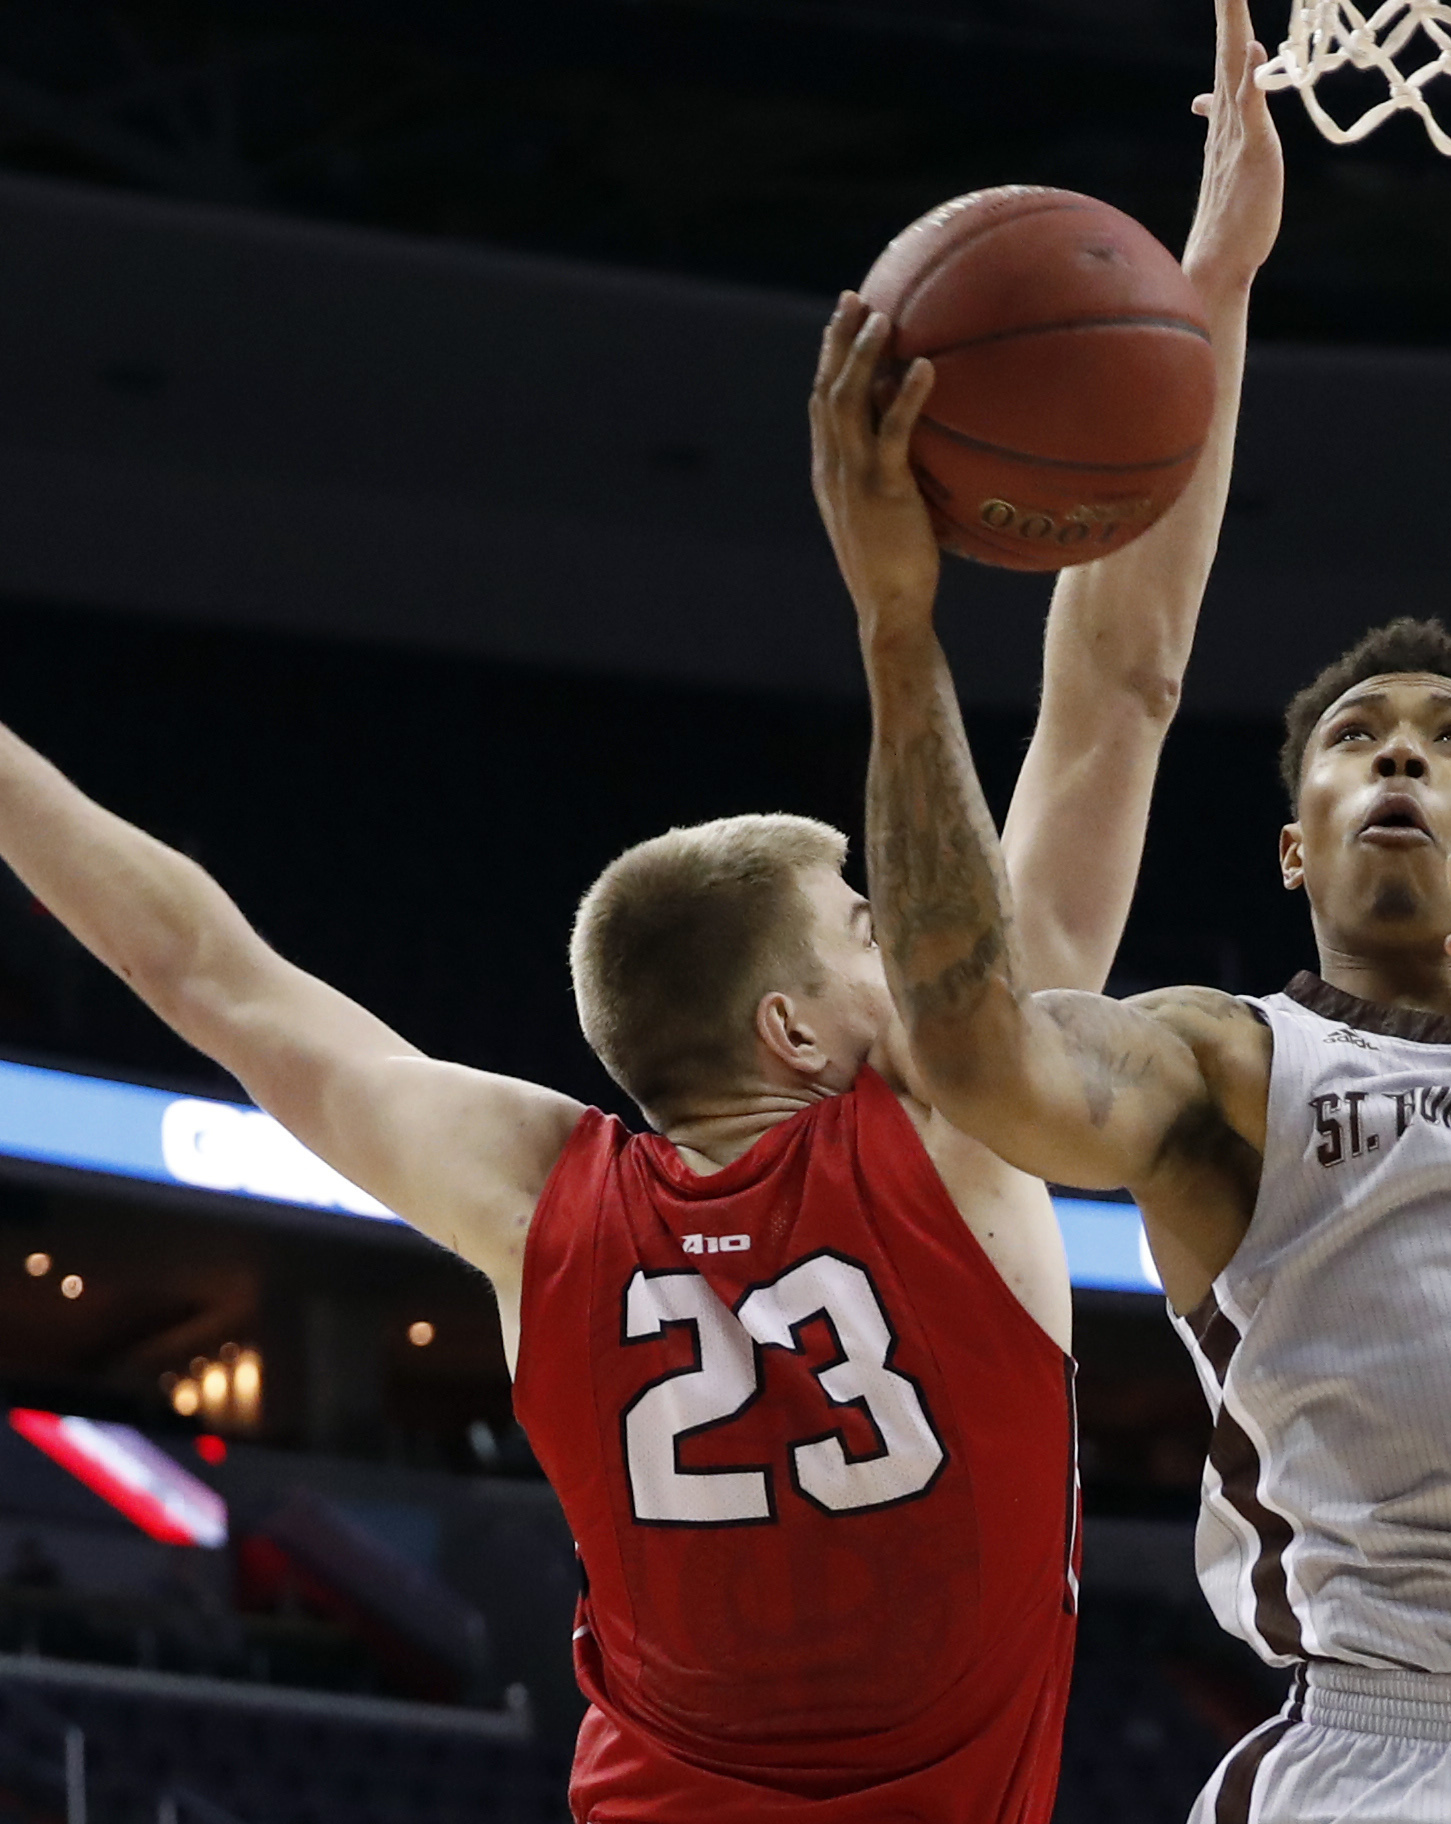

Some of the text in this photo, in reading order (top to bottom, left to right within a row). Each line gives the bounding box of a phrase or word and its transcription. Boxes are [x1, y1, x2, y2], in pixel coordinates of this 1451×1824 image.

[1308, 1090, 1379, 1168] ST.
[681, 1233, 751, 1255] A10
[619, 1247, 950, 1528] 23
